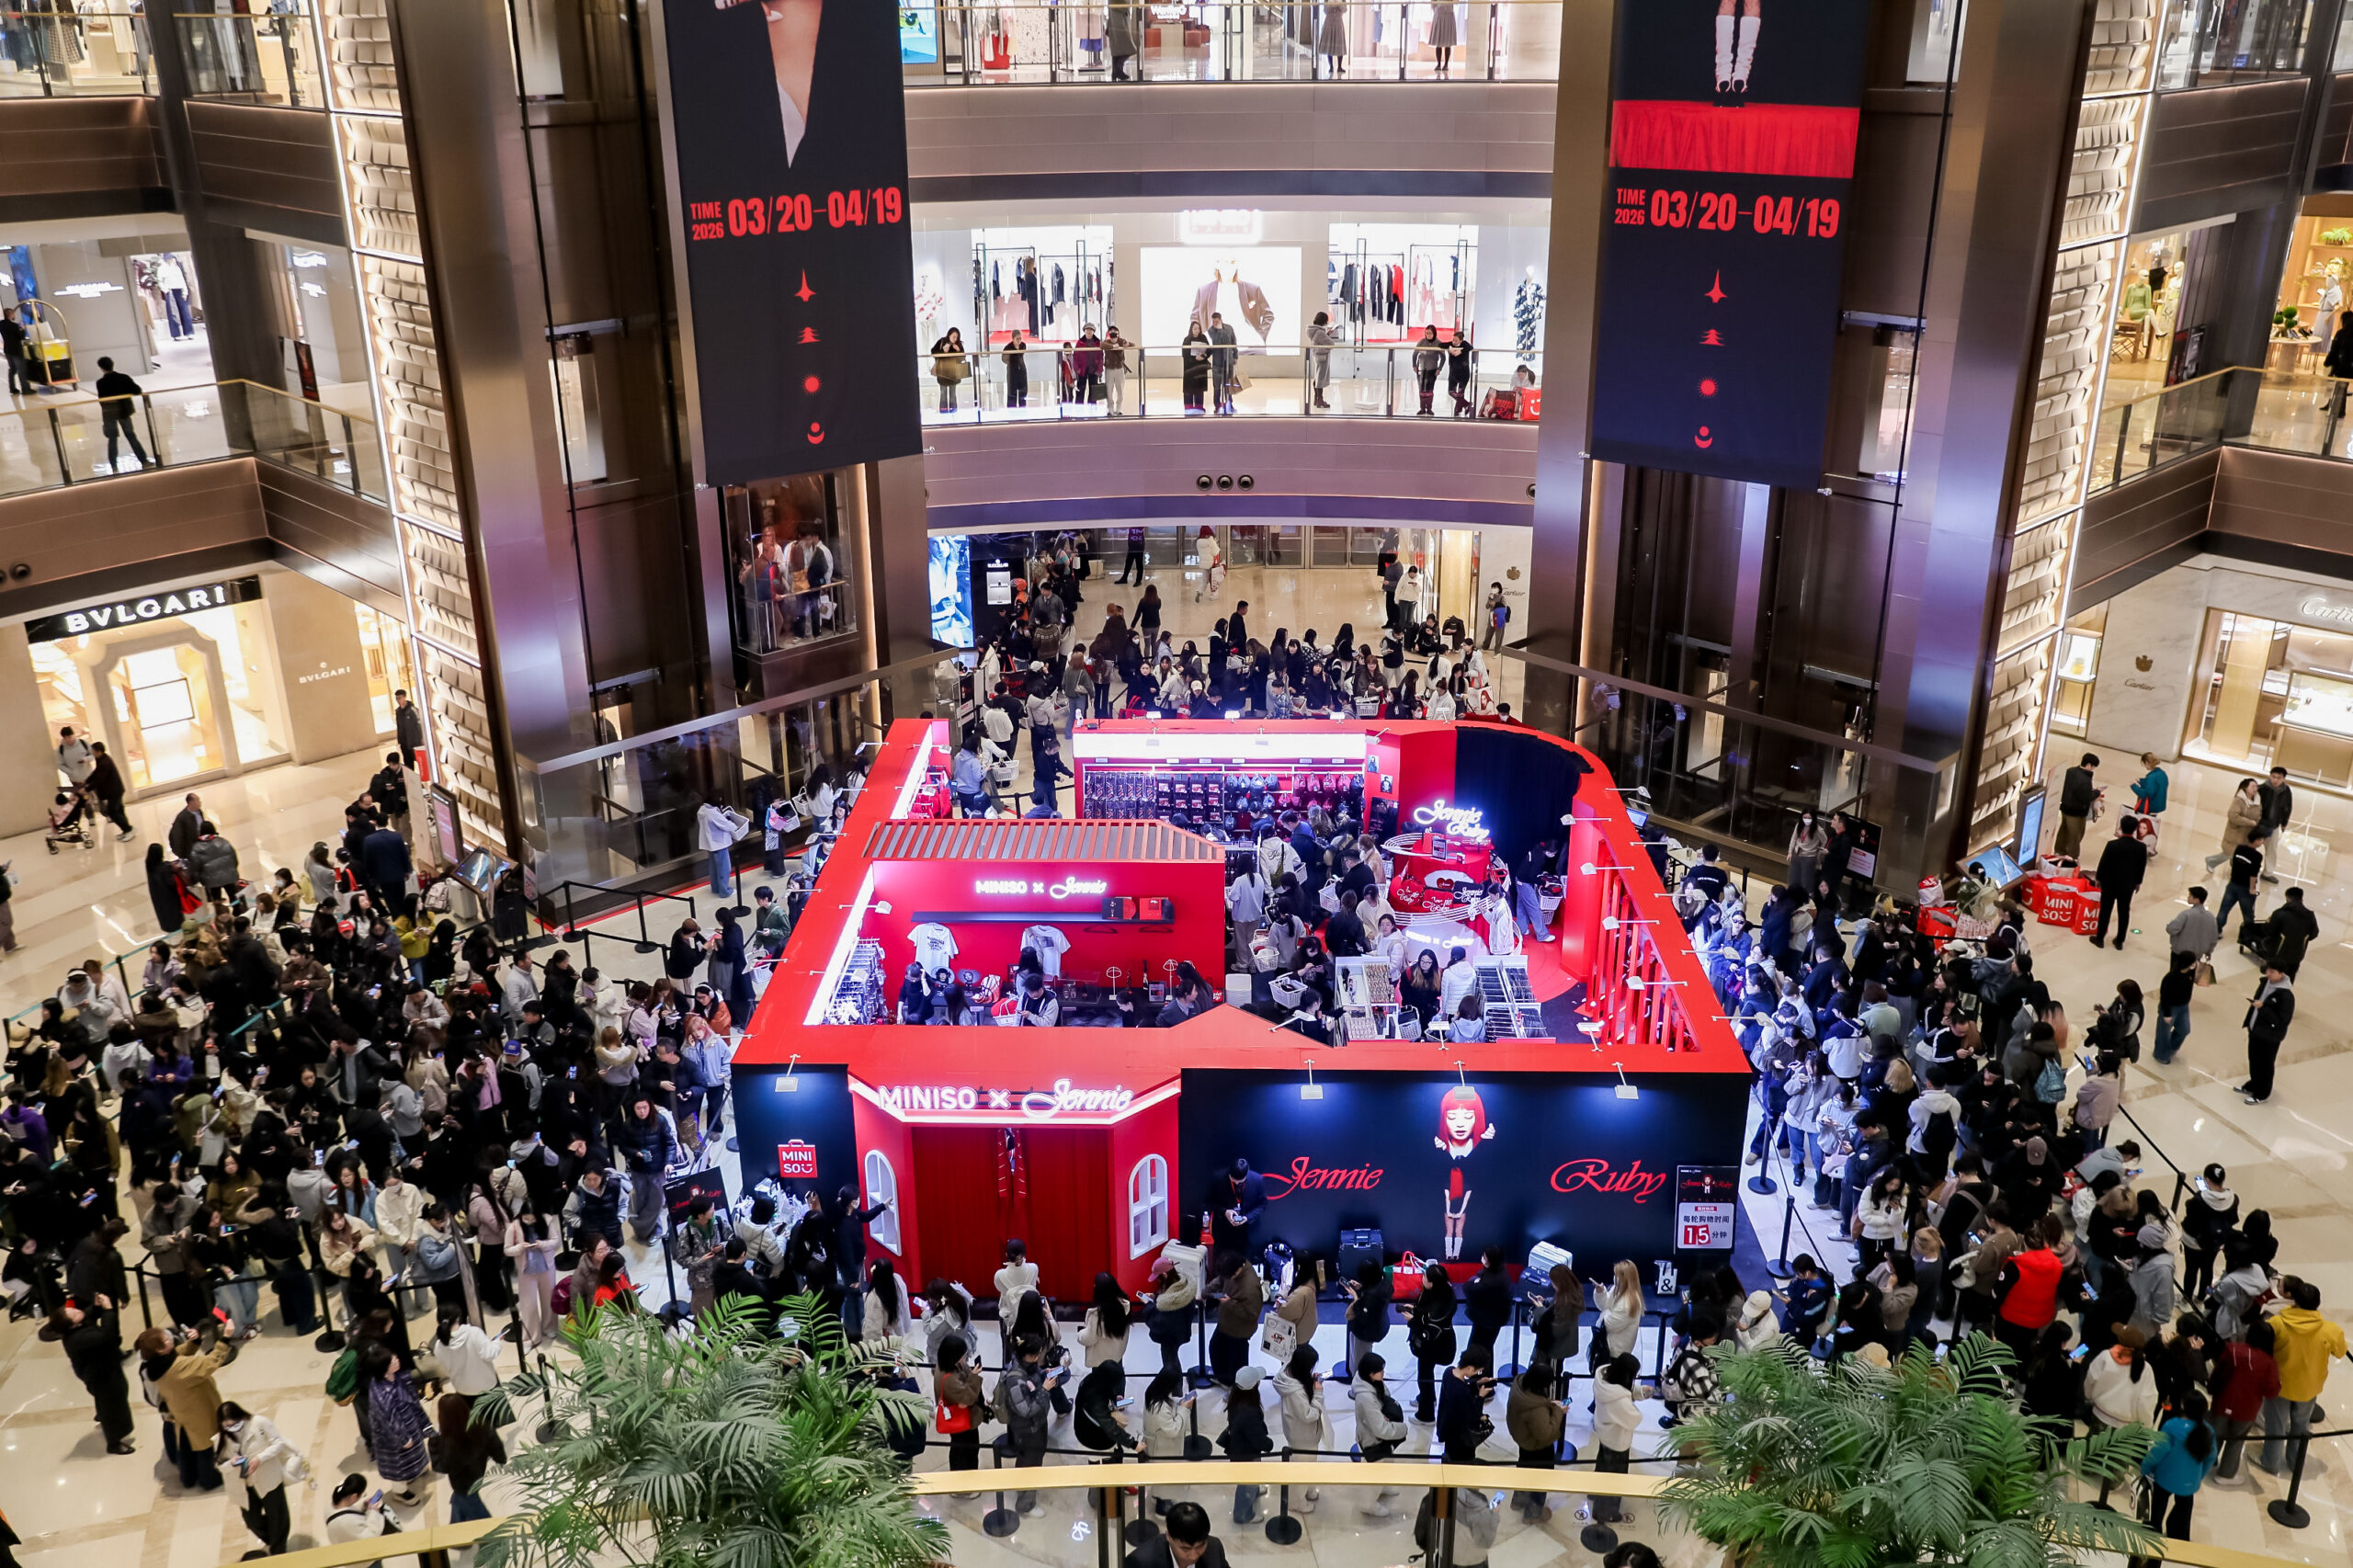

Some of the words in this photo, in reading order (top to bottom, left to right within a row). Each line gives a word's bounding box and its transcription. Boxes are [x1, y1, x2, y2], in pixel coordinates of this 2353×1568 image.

[1616, 188, 1646, 206] TIME
[690, 201, 722, 220] TIME
[1614, 209, 1645, 225] 2026
[692, 222, 724, 240] 2026
[64, 585, 226, 633] BVLGARI
[299, 666, 351, 684] BVLGARI
[975, 881, 1028, 894] MINISO
[2044, 895, 2074, 909] MINI
[877, 1085, 978, 1109] MINISO
[1021, 1077, 1133, 1119] Jennie
[782, 1151, 813, 1162] MINI
[1263, 1156, 1383, 1200] Jennie
[1550, 1159, 1666, 1203] Ruby
[1684, 1215, 1730, 1223] 每轮购物时间
[1687, 1227, 1710, 1244] 15
